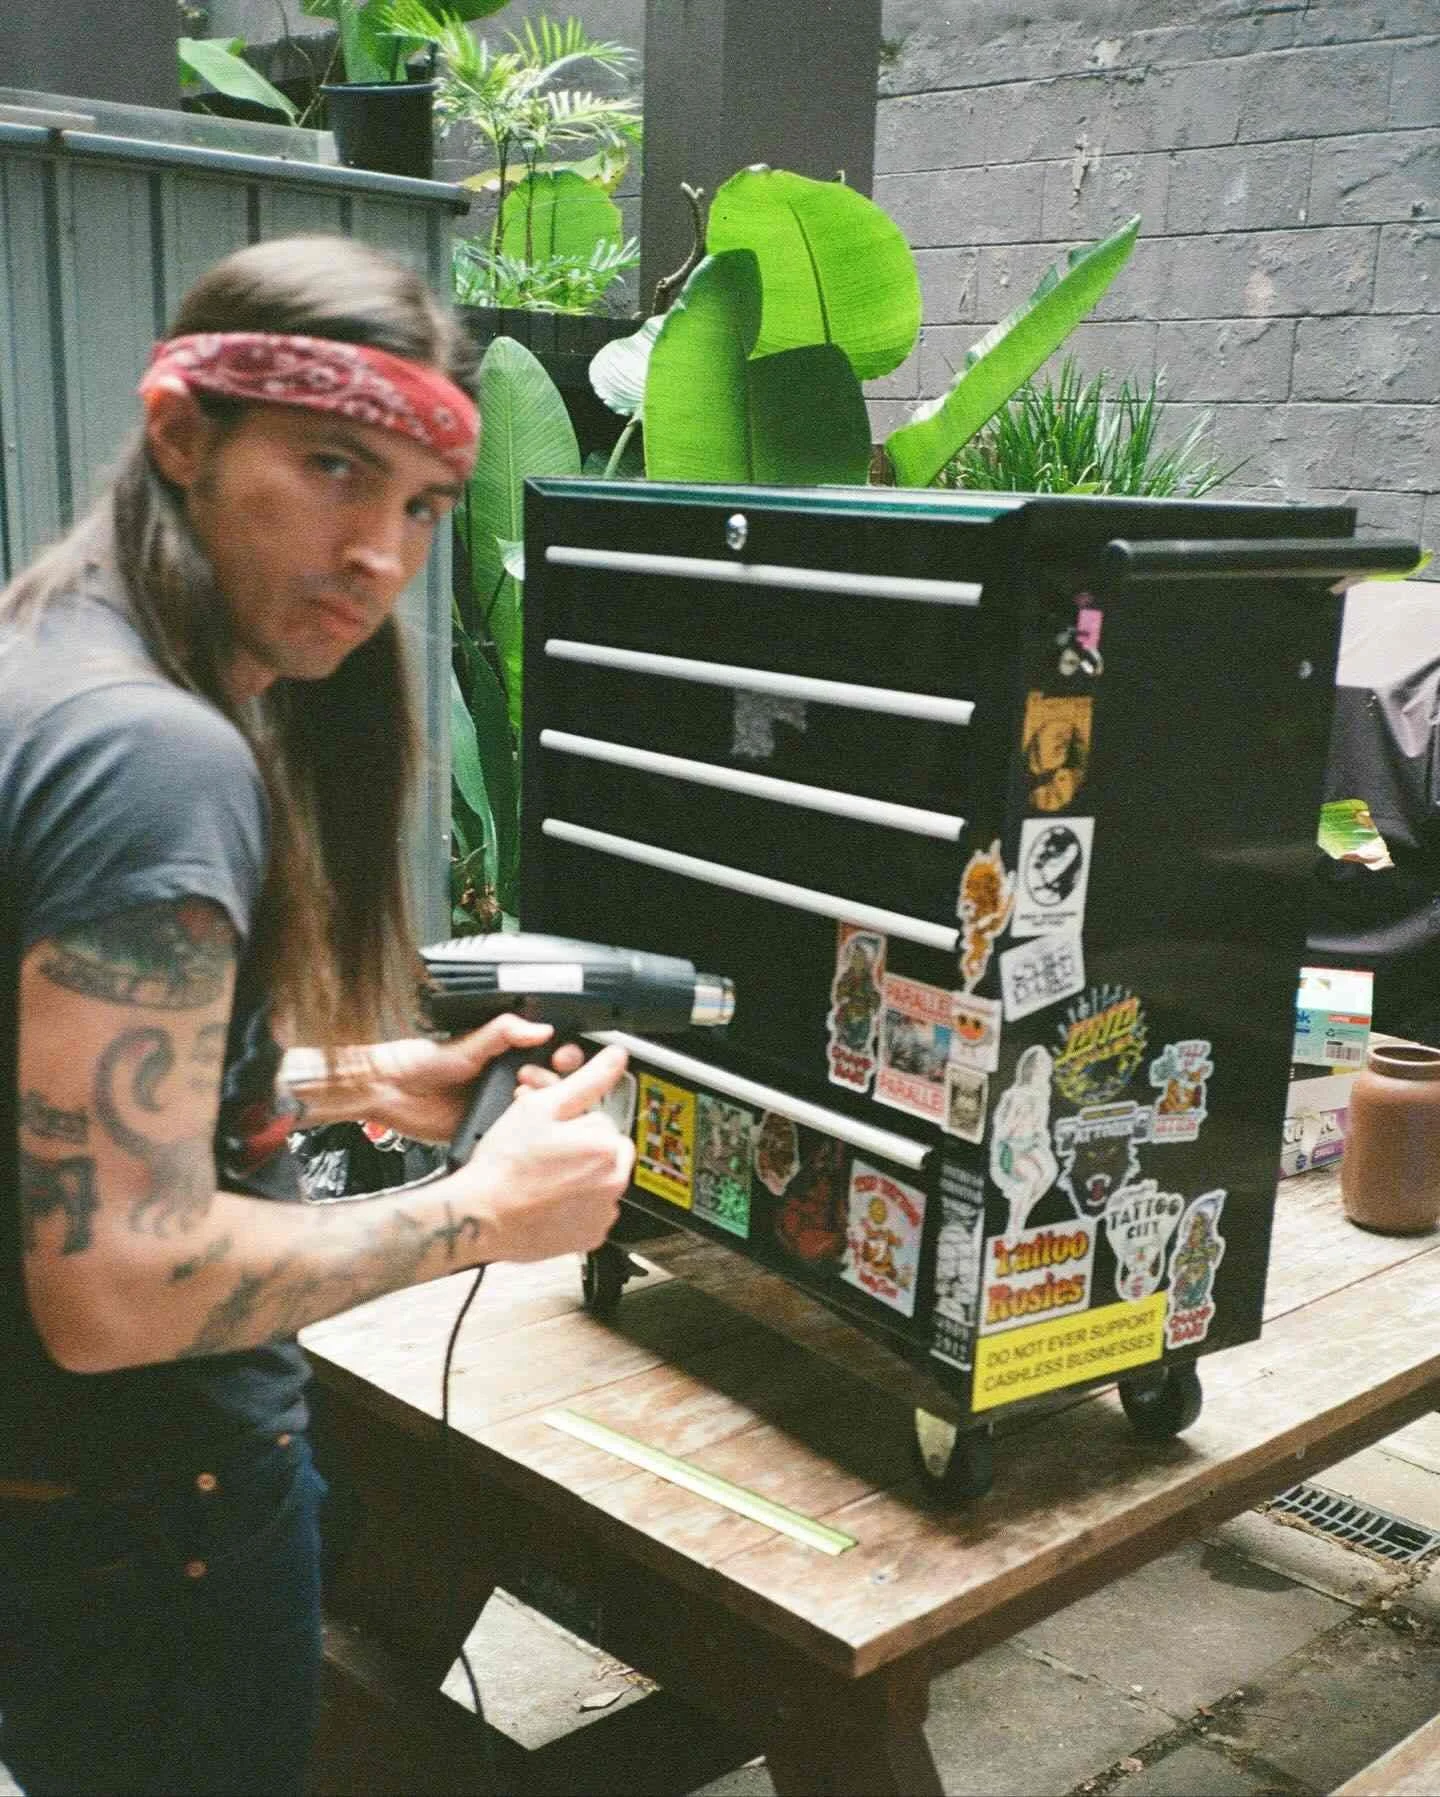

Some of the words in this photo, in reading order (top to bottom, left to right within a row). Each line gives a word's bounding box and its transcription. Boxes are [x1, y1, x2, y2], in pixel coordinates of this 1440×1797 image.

[1109, 1198, 1180, 1231] TATTOO
[982, 1356, 1064, 1392] CASHLESS
[1064, 1333, 1156, 1369] BUSINESSES
[985, 1348, 1010, 1369] DO
[1013, 1339, 1044, 1361] NOT
[1048, 1327, 1087, 1352] EVER
[1089, 1309, 1156, 1340] SUPPORT
